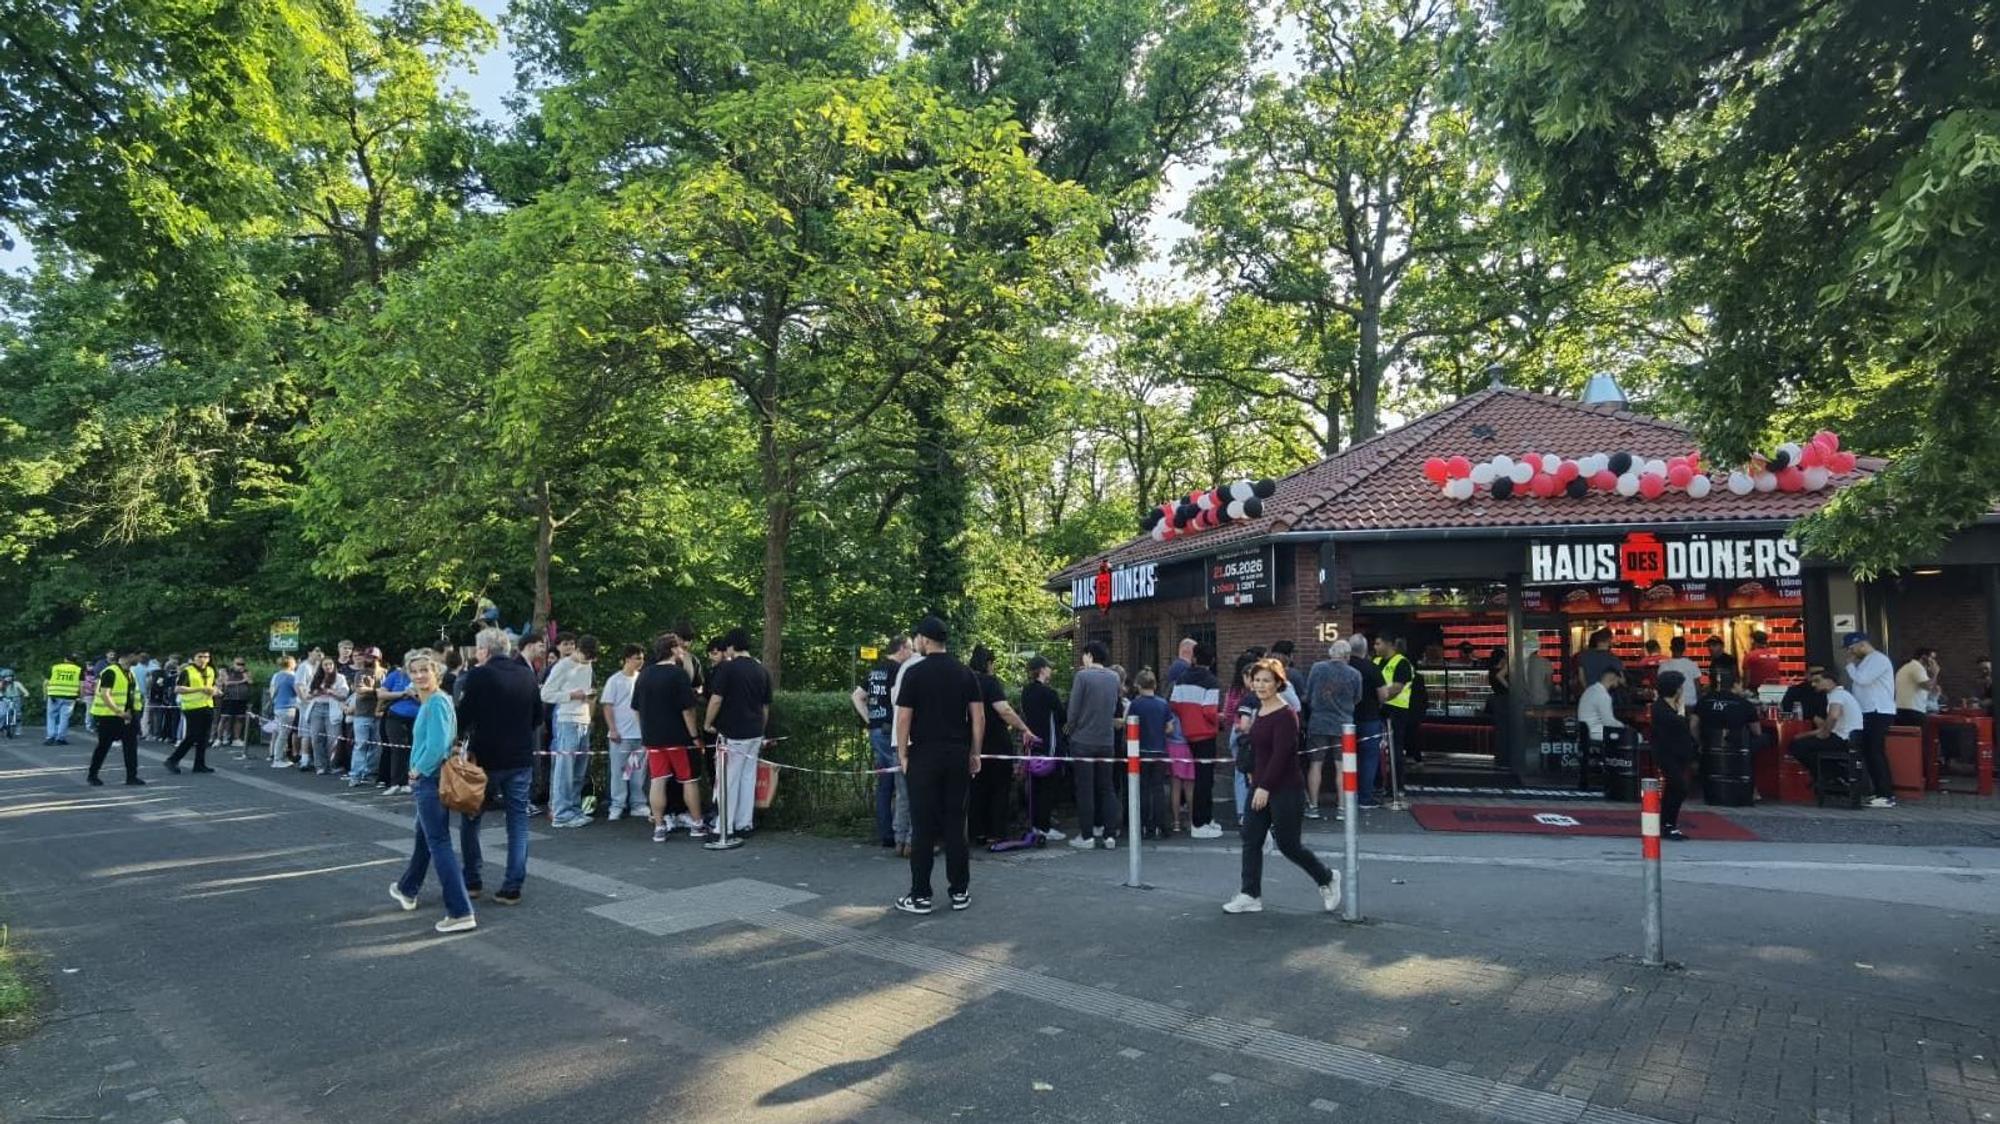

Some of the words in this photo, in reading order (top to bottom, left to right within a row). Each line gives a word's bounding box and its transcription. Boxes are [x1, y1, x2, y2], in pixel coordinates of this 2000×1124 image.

[1531, 543, 1616, 581] HAUS
[1626, 550, 1658, 572] DES
[1666, 534, 1801, 580] DÖNERS
[1072, 575, 1096, 608] HAUS
[1111, 563, 1157, 602] DÖNERS
[1315, 622, 1339, 642] 15
